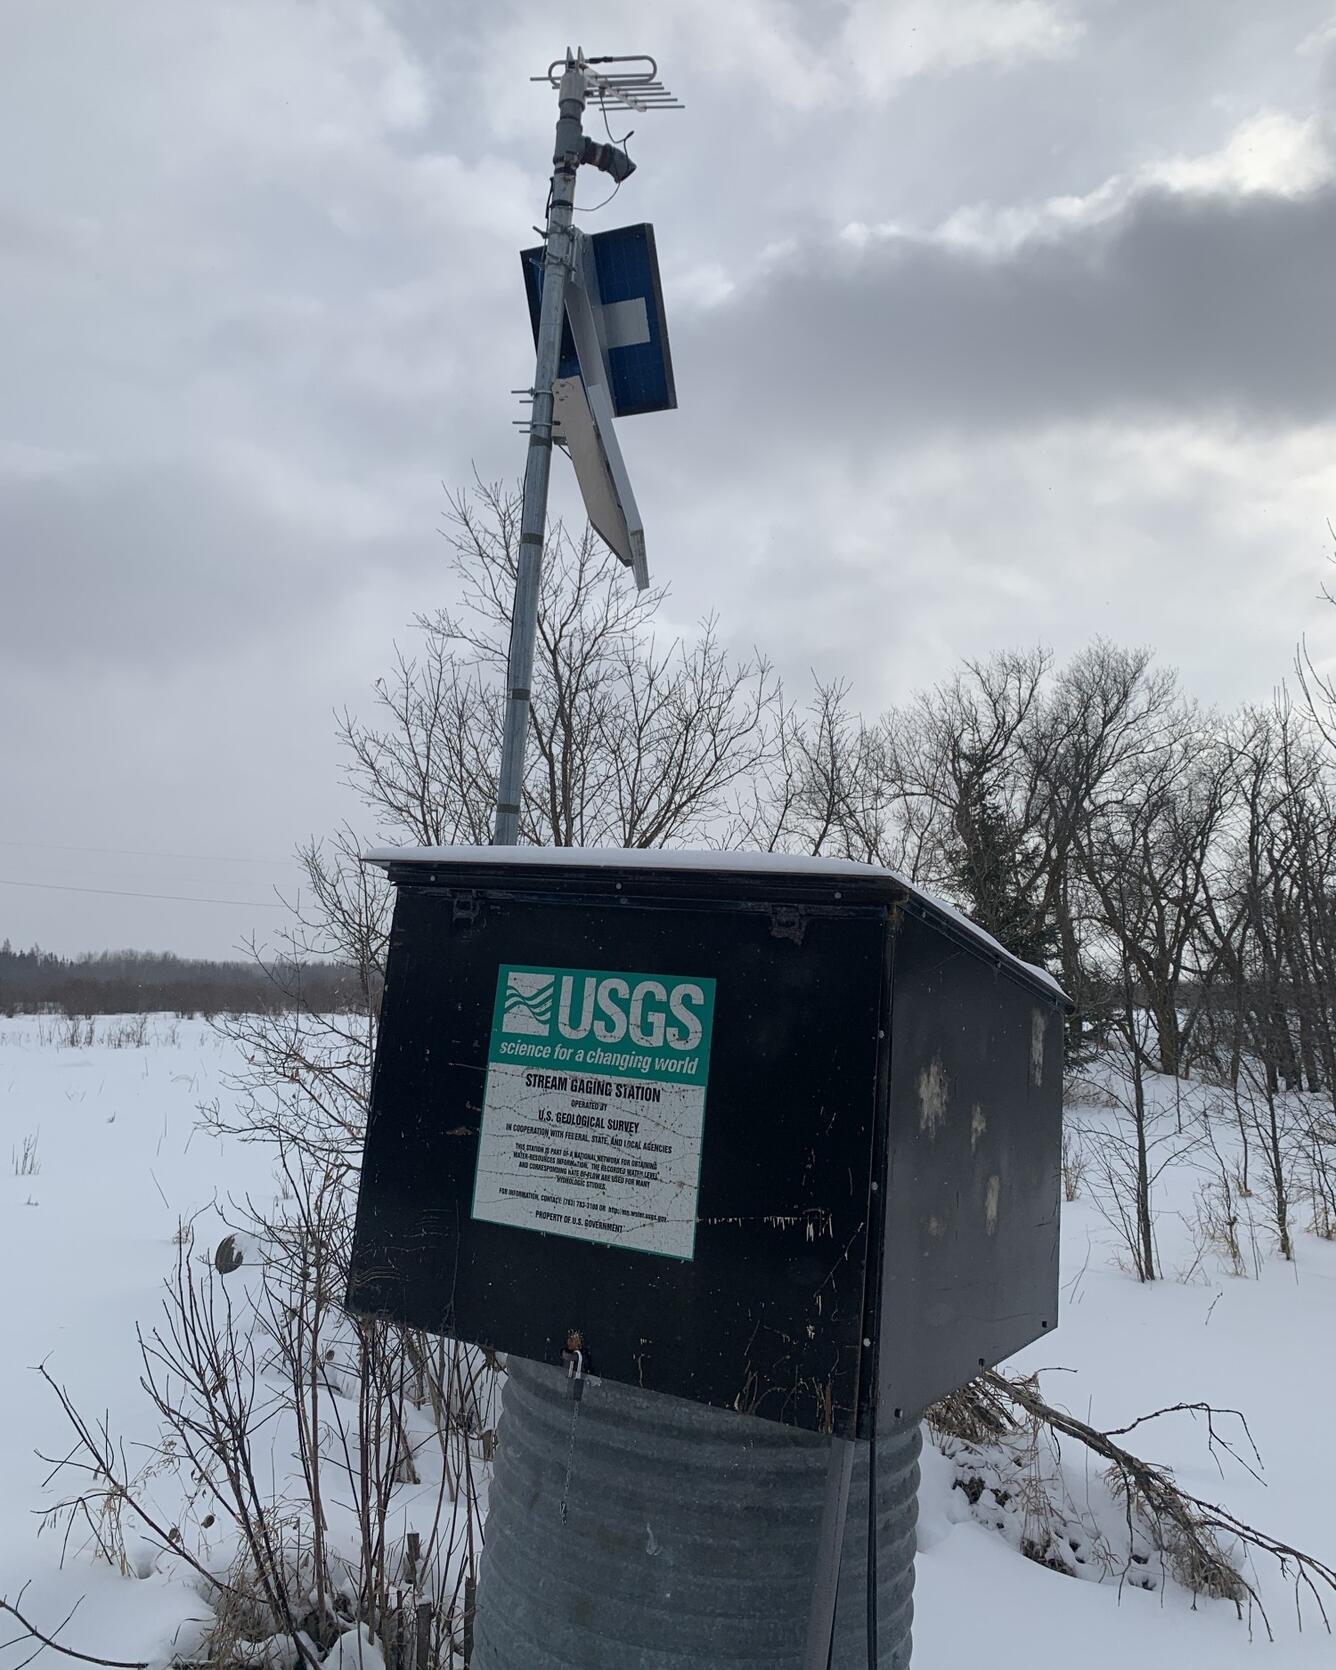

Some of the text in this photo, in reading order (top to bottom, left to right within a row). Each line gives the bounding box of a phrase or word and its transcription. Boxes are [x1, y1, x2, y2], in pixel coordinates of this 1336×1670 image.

[558, 976, 705, 1051] USGS
[500, 1040, 698, 1075] science for a changing world
[526, 1072, 660, 1102] STREAM GAGING STATION
[571, 1099, 607, 1111] OPERATED BY
[539, 1109, 639, 1133] U.S. GEOLOGICAL SURVEY
[513, 1124, 548, 1135] COOPERATION
[550, 1129, 563, 1138] WITH
[611, 1138, 622, 1146] AND
[624, 1140, 641, 1149] LOCAL
[643, 1142, 672, 1154] AGENCIES
[527, 1144, 544, 1152] STATION
[575, 1151, 596, 1160] NATIONAL
[597, 1155, 619, 1164] NETWORK
[620, 1158, 630, 1166] FOR
[632, 1160, 657, 1170] OBTAINING
[530, 1162, 566, 1174] CORRESPONDING
[612, 1176, 624, 1184] USED
[636, 1179, 650, 1188] MANY
[557, 1176, 585, 1186] HYDROLOGIC
[591, 1163, 599, 1171] THE
[601, 1164, 625, 1175] RECORDED
[645, 1171, 658, 1180] LEVEL
[498, 1187, 508, 1195] FOR
[598, 1204, 606, 1212] OR
[536, 1210, 622, 1233] PROPERTY OF U.S. GOVERNMENT
